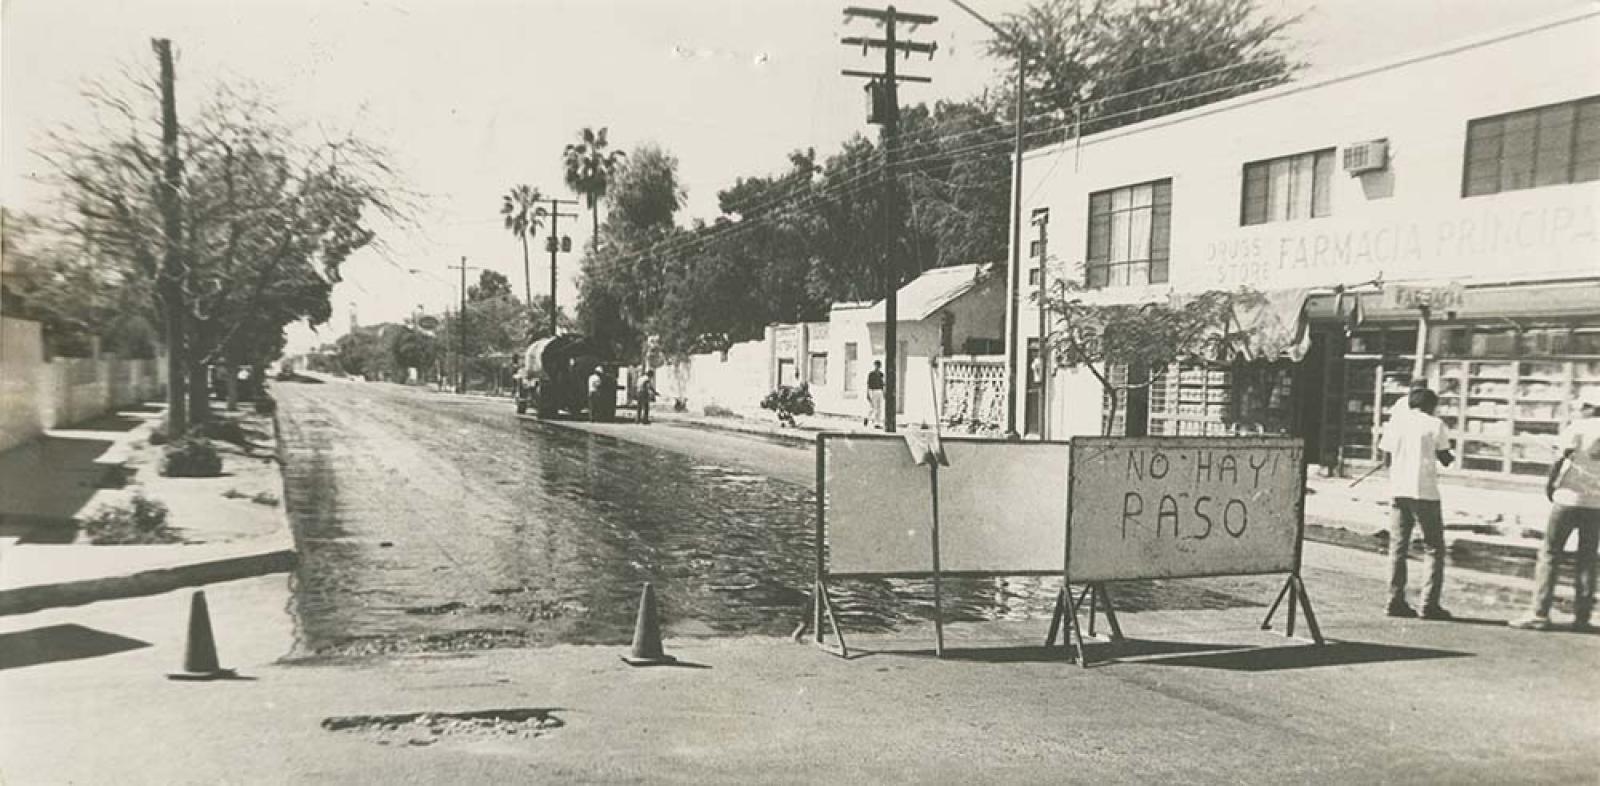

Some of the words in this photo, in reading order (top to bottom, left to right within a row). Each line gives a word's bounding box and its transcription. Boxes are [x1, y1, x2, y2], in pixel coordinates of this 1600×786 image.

[1207, 237, 1261, 262] DRUGS
[1279, 221, 1422, 269] FARMACIA
[1217, 262, 1269, 283] STORE
[1127, 451, 1169, 480] NO
